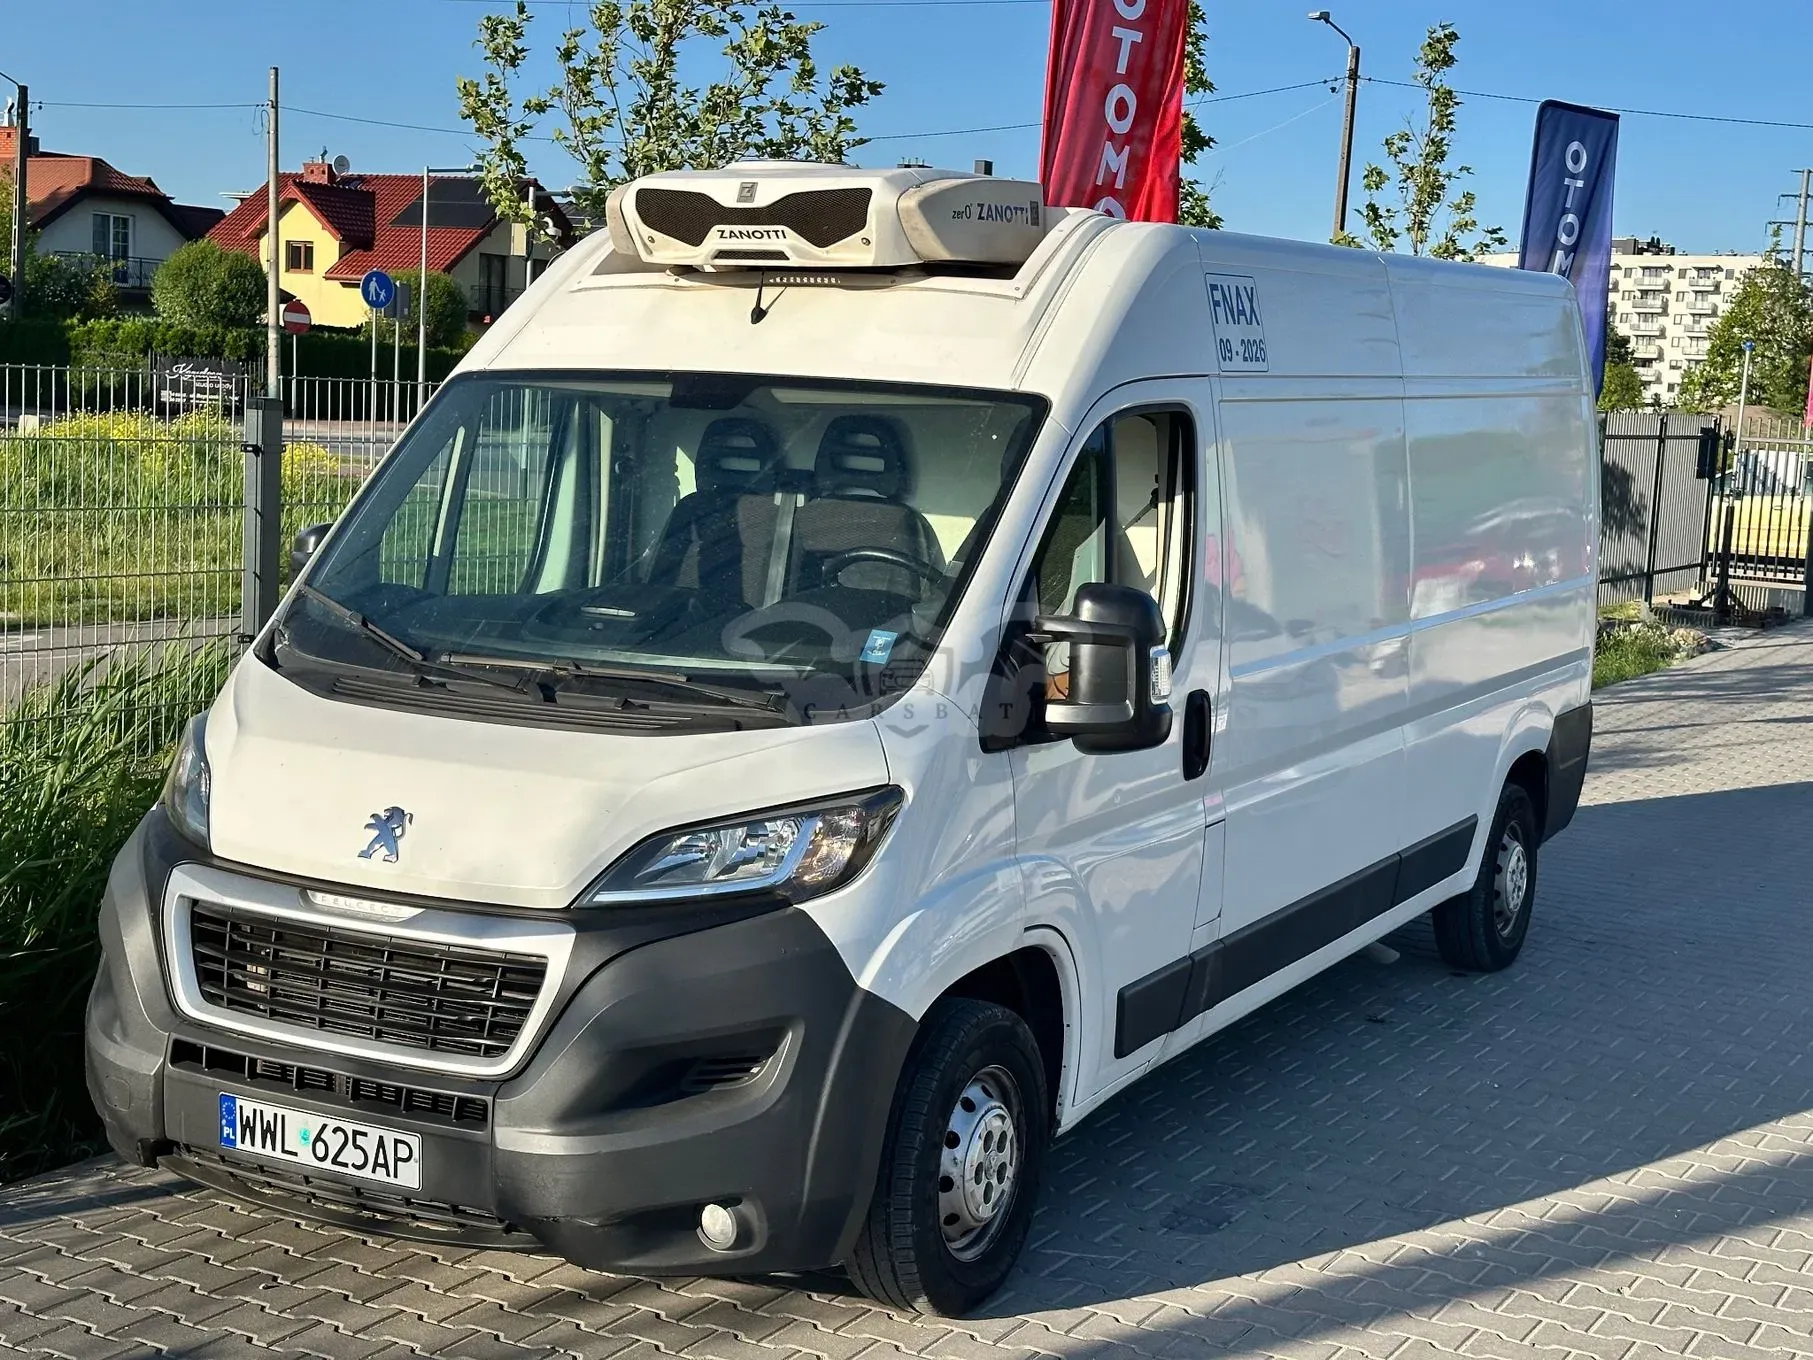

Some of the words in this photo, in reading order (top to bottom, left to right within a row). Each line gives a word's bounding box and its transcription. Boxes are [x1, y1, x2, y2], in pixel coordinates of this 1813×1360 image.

[717, 229, 787, 240] ZANOTTI
[1209, 283, 1260, 326] FNAX
[1219, 338, 1233, 362] 09
[1240, 339, 1266, 363] 2026
[223, 1126, 236, 1140] PL
[239, 1104, 298, 1157] WWL
[311, 1123, 414, 1179] 625AP
